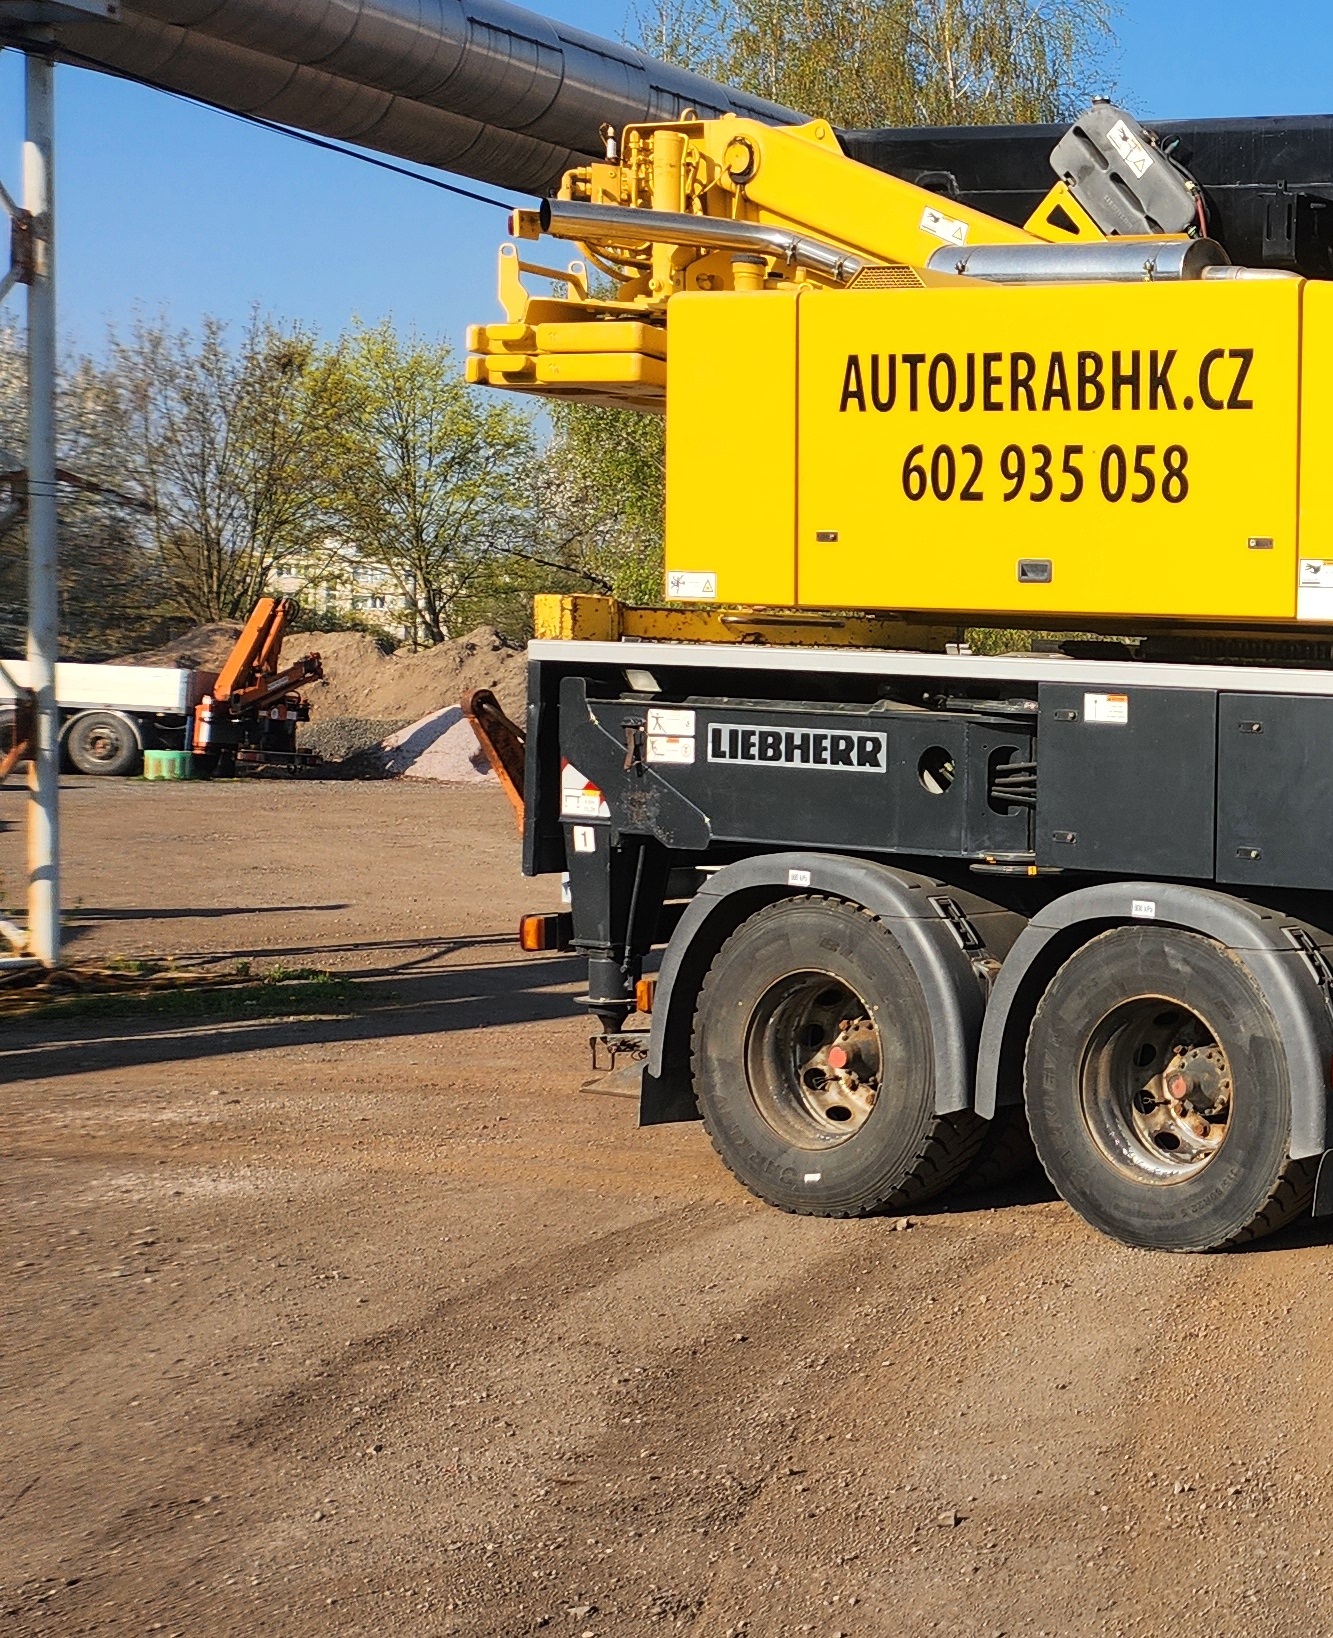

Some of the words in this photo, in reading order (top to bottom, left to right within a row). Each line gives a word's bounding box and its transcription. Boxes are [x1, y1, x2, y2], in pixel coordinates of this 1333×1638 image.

[839, 348, 1254, 412] AUTOJERABHK.CZ
[901, 443, 984, 502] 602
[1000, 443, 1084, 503] 935
[1099, 443, 1190, 503] 058
[711, 727, 883, 768] LIEBHERR
